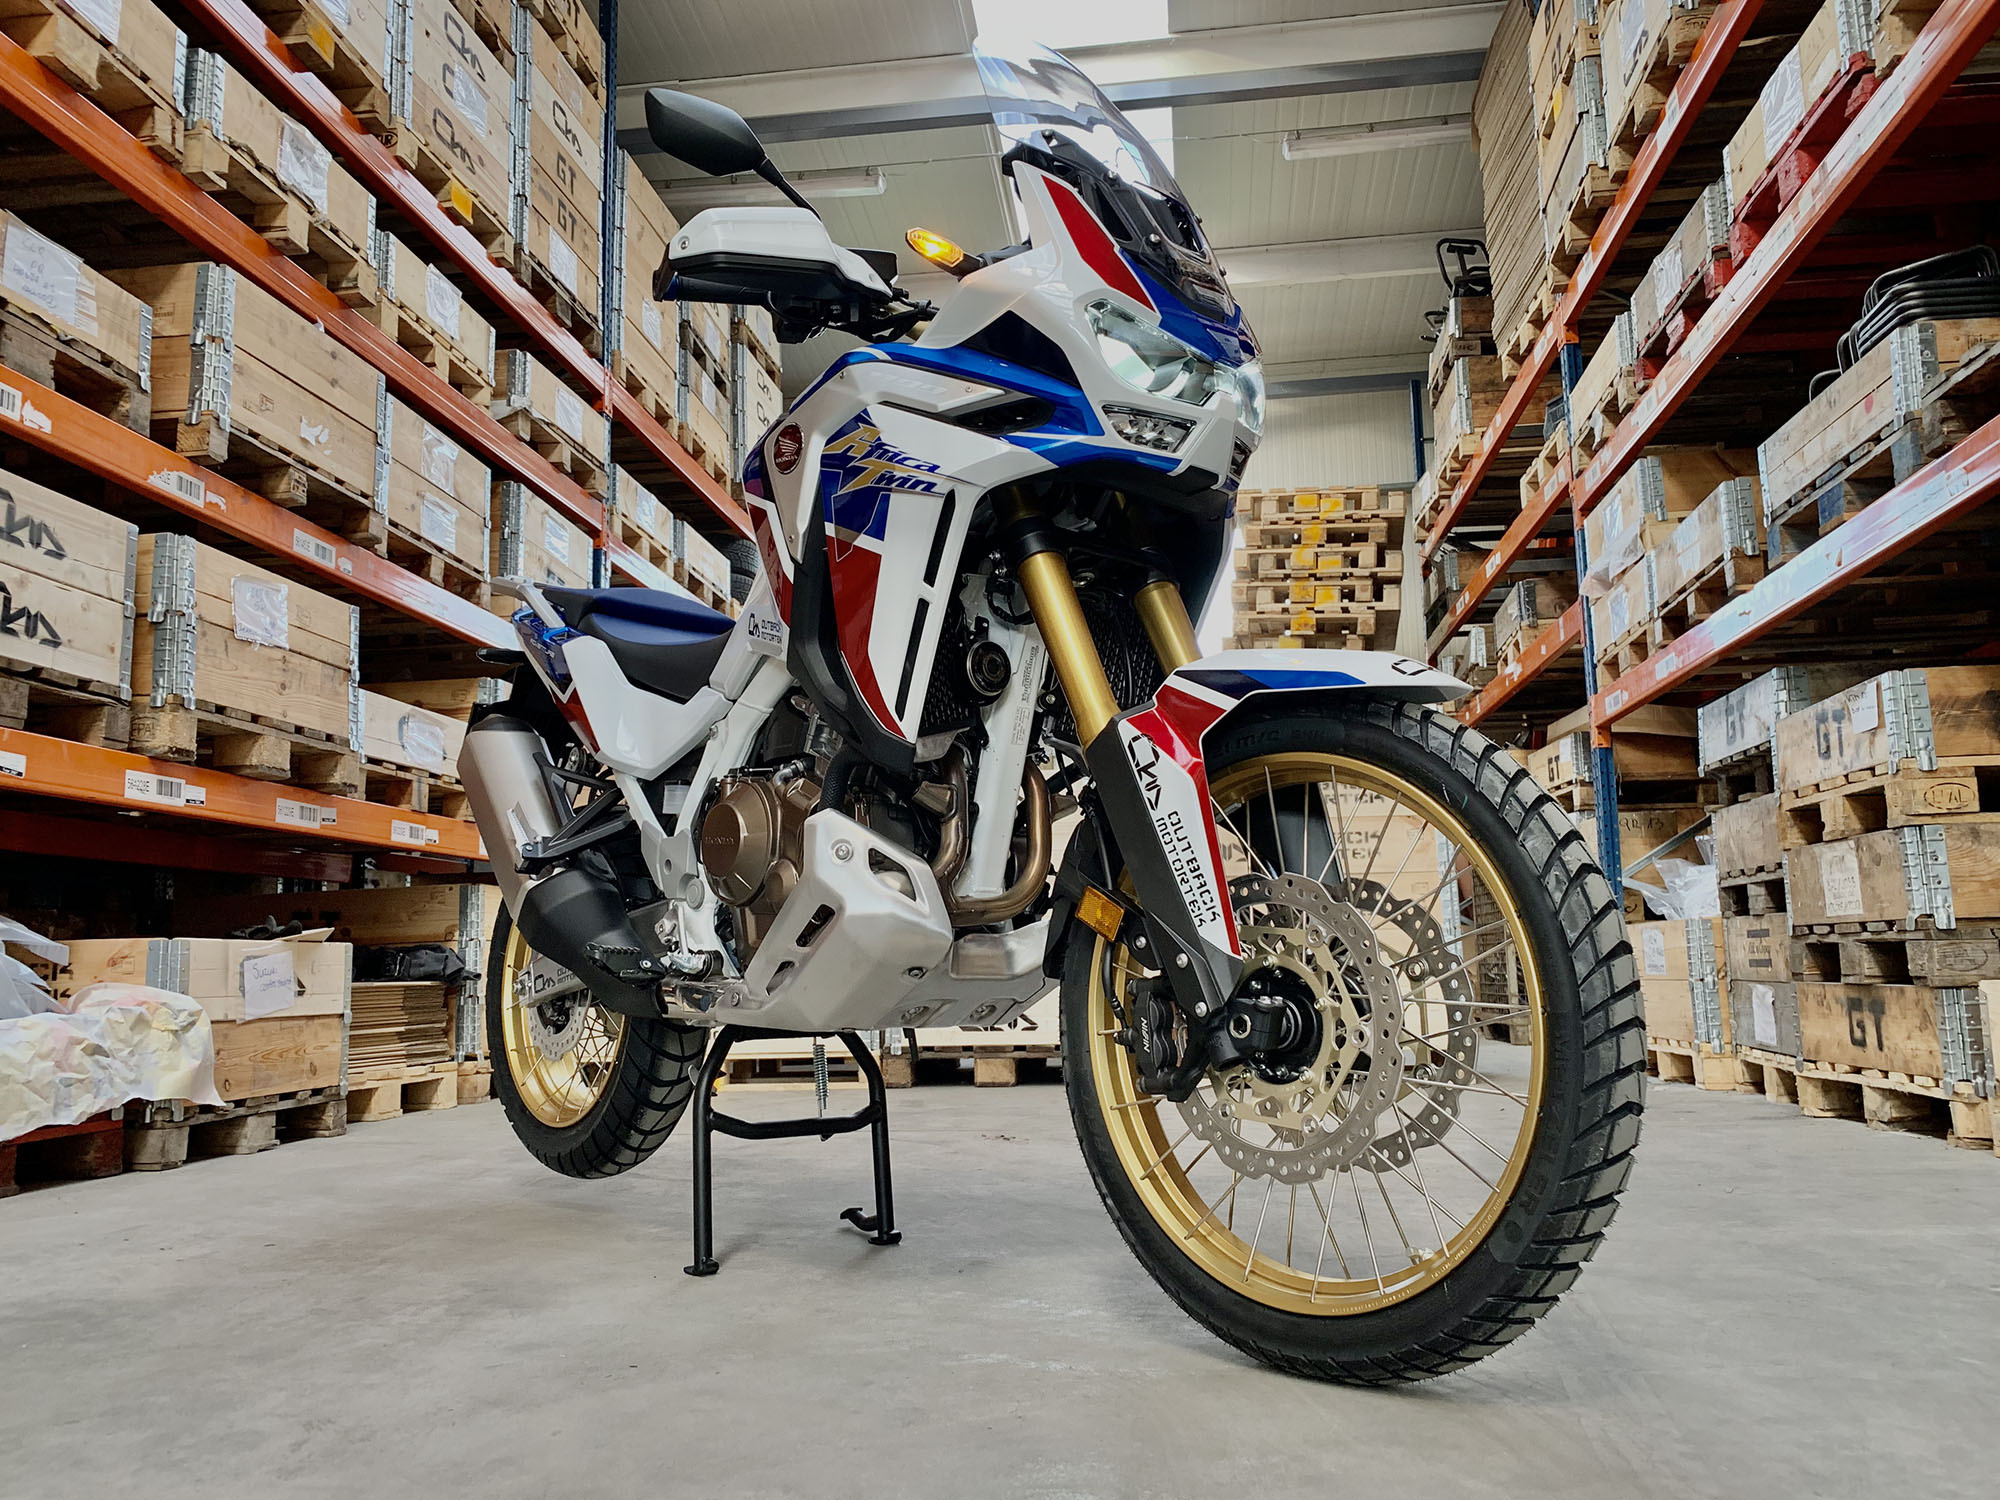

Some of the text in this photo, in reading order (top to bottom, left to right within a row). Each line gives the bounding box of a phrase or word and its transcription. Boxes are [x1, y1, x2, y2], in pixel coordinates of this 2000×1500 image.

[557, 151, 577, 195] GT
[558, 198, 578, 242] GT
[776, 453, 798, 464] HONDA
[823, 423, 943, 475] Africa
[839, 458, 947, 496] Twin
[1725, 694, 1746, 745] GT
[1815, 708, 1847, 760] GT
[1548, 754, 1560, 783] GT
[1167, 810, 1221, 922] OUTBACK
[1140, 1016, 1151, 1054] NISSIN
[1847, 996, 1886, 1051] GT
